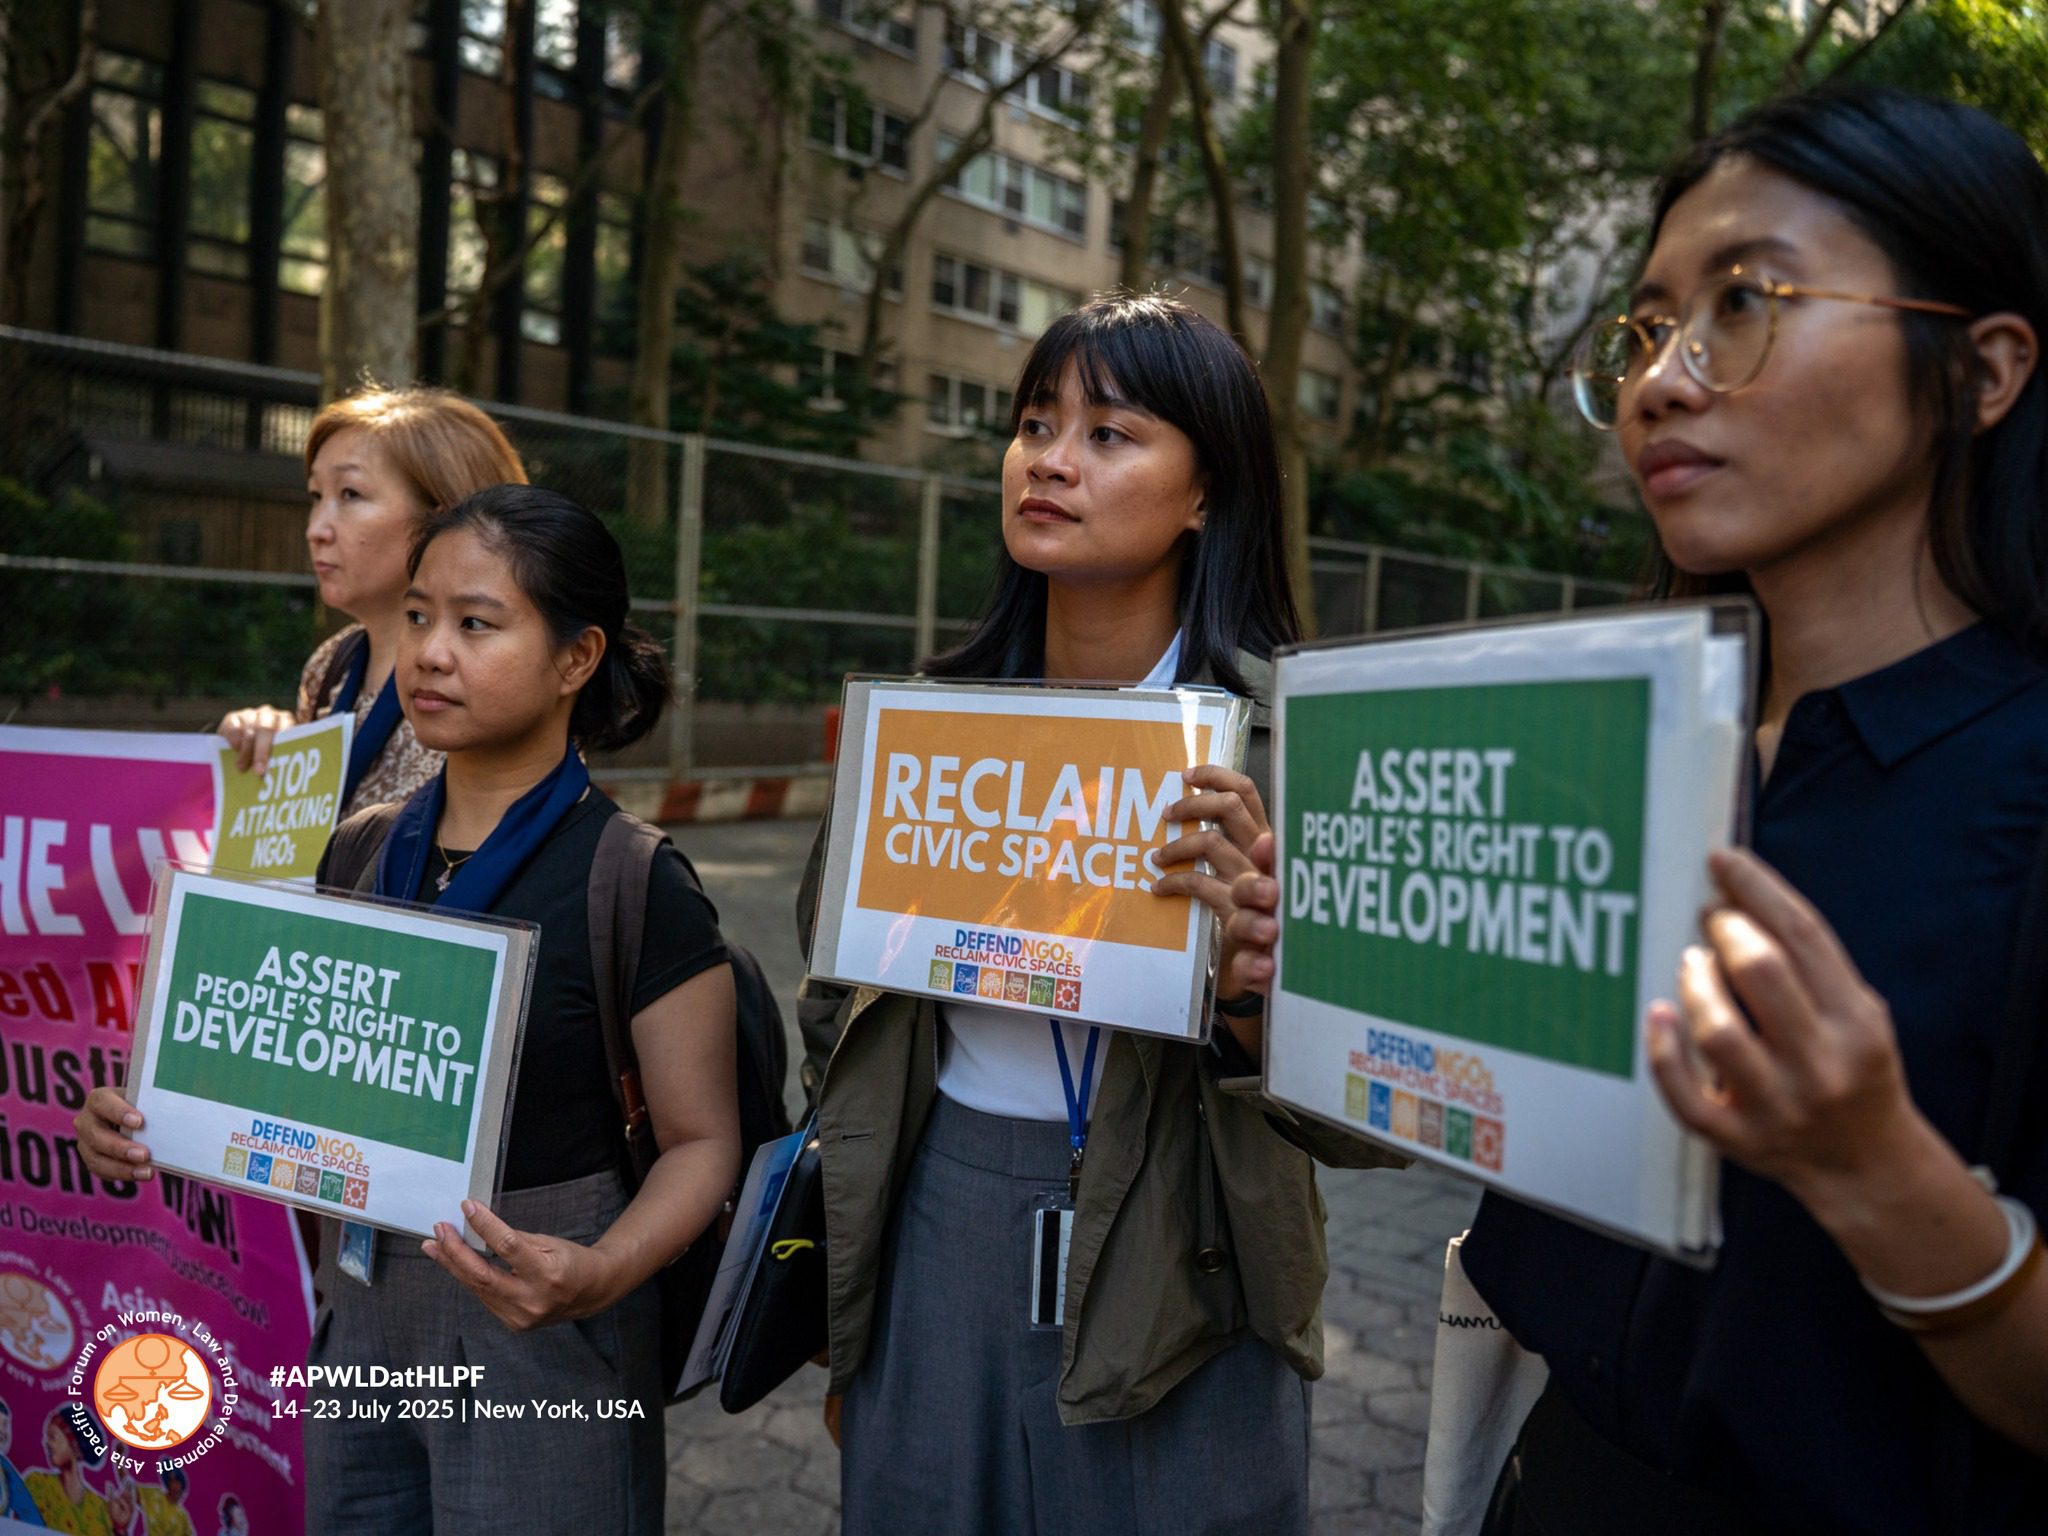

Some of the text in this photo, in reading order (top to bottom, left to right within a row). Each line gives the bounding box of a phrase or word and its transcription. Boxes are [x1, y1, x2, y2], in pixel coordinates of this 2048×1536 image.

[258, 748, 321, 802] STOP
[882, 752, 1184, 844] RECLAIM
[1350, 748, 1515, 819] ASSERT
[229, 793, 334, 838] ATTACKING
[1301, 811, 1613, 887] PEOPLE’S RIGHT TO
[250, 833, 297, 869] NGOs
[884, 823, 1166, 893] CIVIC SPACES
[1290, 857, 1636, 978] DEVELOPMENT
[255, 946, 401, 1008] ASSERT
[934, 944, 1082, 978] RECLAIM CIVIC SPACES
[194, 972, 461, 1057] PEOPLE’S RIGHT TO
[173, 1000, 475, 1107] DEVELOPMENT
[230, 1131, 371, 1178] RECLAIM CIVIC SPACES
